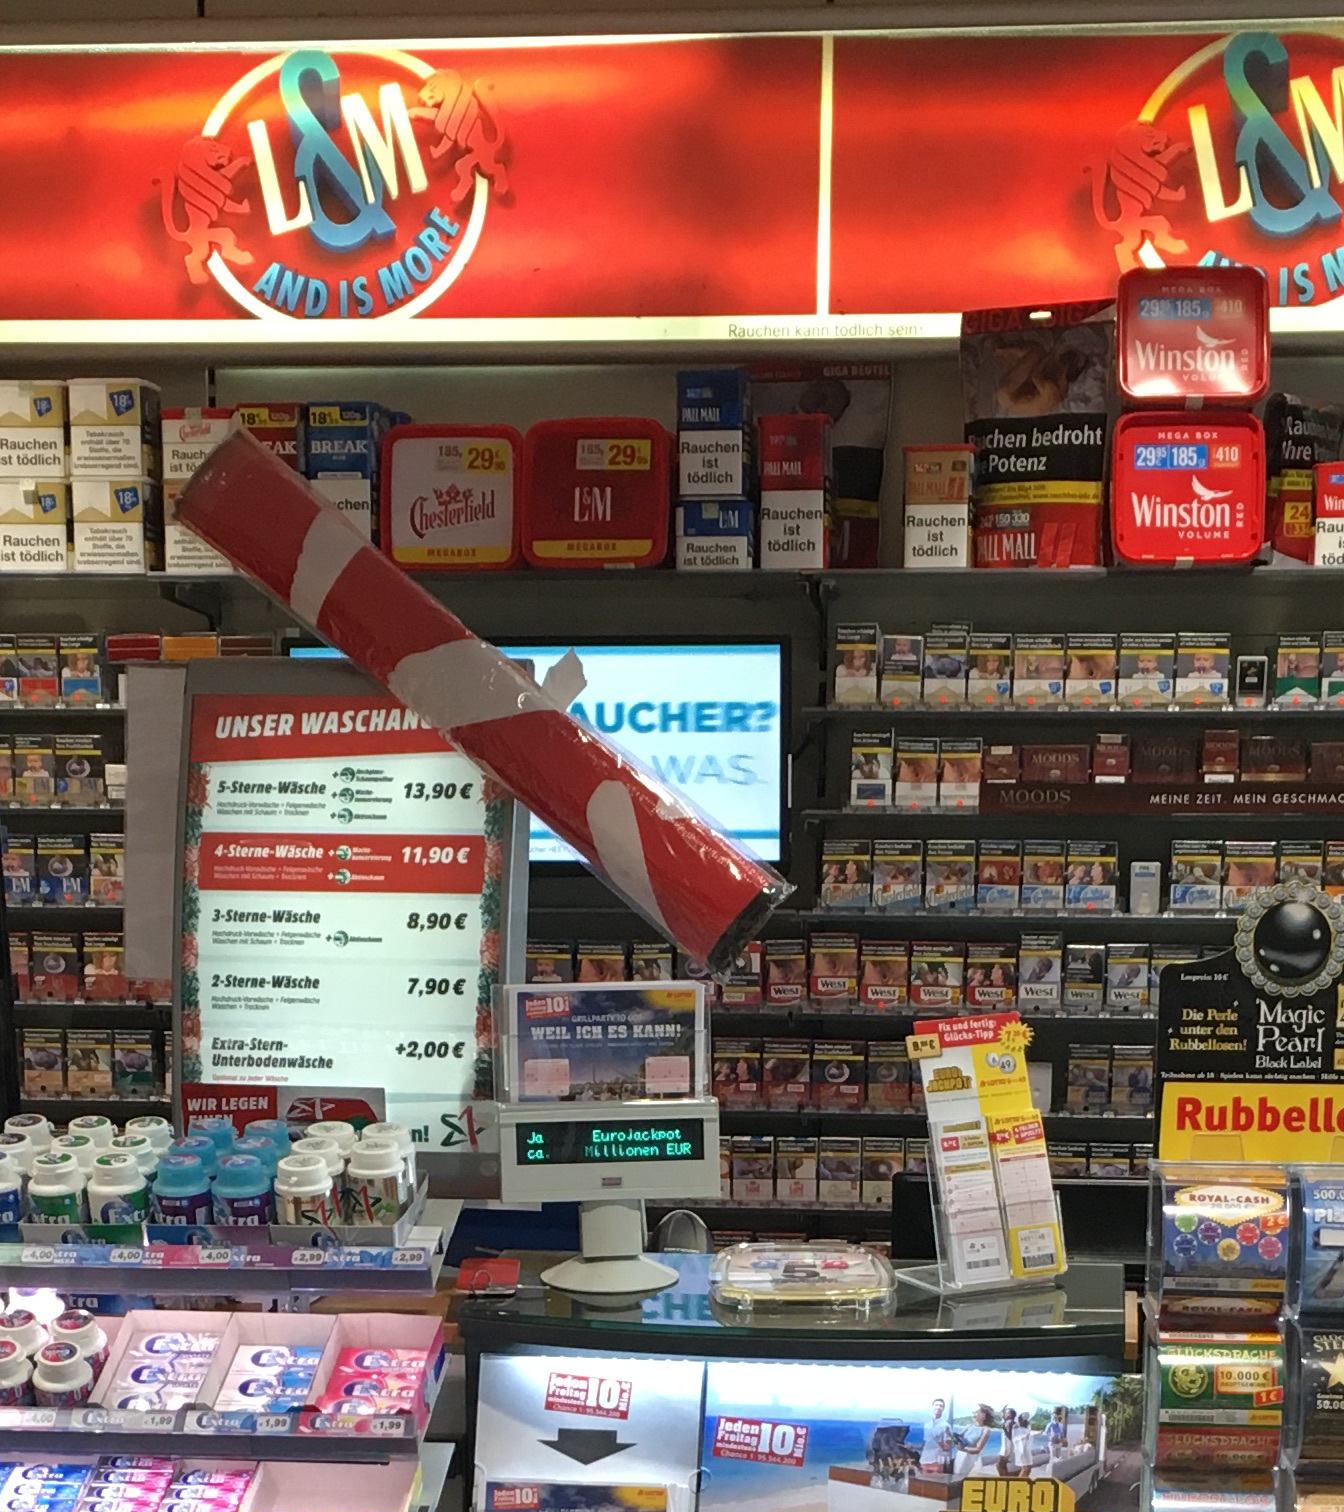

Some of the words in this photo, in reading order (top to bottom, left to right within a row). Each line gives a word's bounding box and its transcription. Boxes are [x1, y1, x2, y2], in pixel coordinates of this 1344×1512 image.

[253, 262, 327, 318] AND
[337, 276, 374, 316] IS
[383, 205, 461, 306] MORE
[728, 324, 790, 338] Rauchen
[1135, 339, 1235, 371] Winston
[1032, 424, 1103, 447] bedroht
[310, 439, 368, 456] BREAK
[681, 441, 740, 456] Rauchen
[702, 457, 720, 470] ist
[989, 454, 1047, 472] Potenz
[687, 471, 733, 485] tödlich
[574, 486, 612, 522] L&M
[1131, 492, 1230, 528] Winston
[410, 489, 495, 539] Chesterfield
[1178, 531, 1229, 539] VOLUME
[566, 701, 777, 733] AUCHER?
[215, 713, 293, 739] UNSER
[217, 781, 326, 795] 5-Sterne-Wäsche
[404, 783, 456, 801] 13,90
[457, 783, 473, 799] €
[214, 844, 324, 859] 4-Sterne-Wäsche
[402, 847, 453, 866] 11,90
[457, 847, 470, 863] €
[212, 909, 321, 924] 3-Sterne-Wäsche
[407, 913, 451, 931] 8,90
[454, 913, 467, 929] €
[212, 975, 320, 990] 2-Sterne-Wäsche
[407, 978, 450, 996] 7,90
[453, 979, 466, 995] €
[1182, 1008, 1203, 1021] Die
[1207, 1009, 1238, 1021] Perle
[1256, 998, 1326, 1033] Magic
[531, 1027, 571, 1040] WEIL
[576, 1025, 602, 1039] ICH
[606, 1025, 628, 1038] ES
[633, 1024, 681, 1038] KANN!
[1180, 1025, 1212, 1035] unter
[1215, 1024, 1237, 1035] den
[212, 1038, 288, 1052] Extra-Stern-
[1169, 1039, 1247, 1051] Rubbellosen!
[1256, 1025, 1324, 1052] Pearl
[395, 1042, 450, 1060] +2,00
[452, 1042, 465, 1058] €
[212, 1054, 334, 1069] Unterbodenwäsche
[1256, 1056, 1287, 1068] Black
[1290, 1056, 1322, 1068] Label
[187, 1099, 217, 1111] WIR
[222, 1097, 268, 1110] LEGEN
[667, 1143, 692, 1155] EUR
[1218, 1370, 1257, 1383] 10.000
[718, 1418, 759, 1434] Jeden
[717, 1430, 758, 1446] Freitag
[758, 1422, 795, 1457] 10
